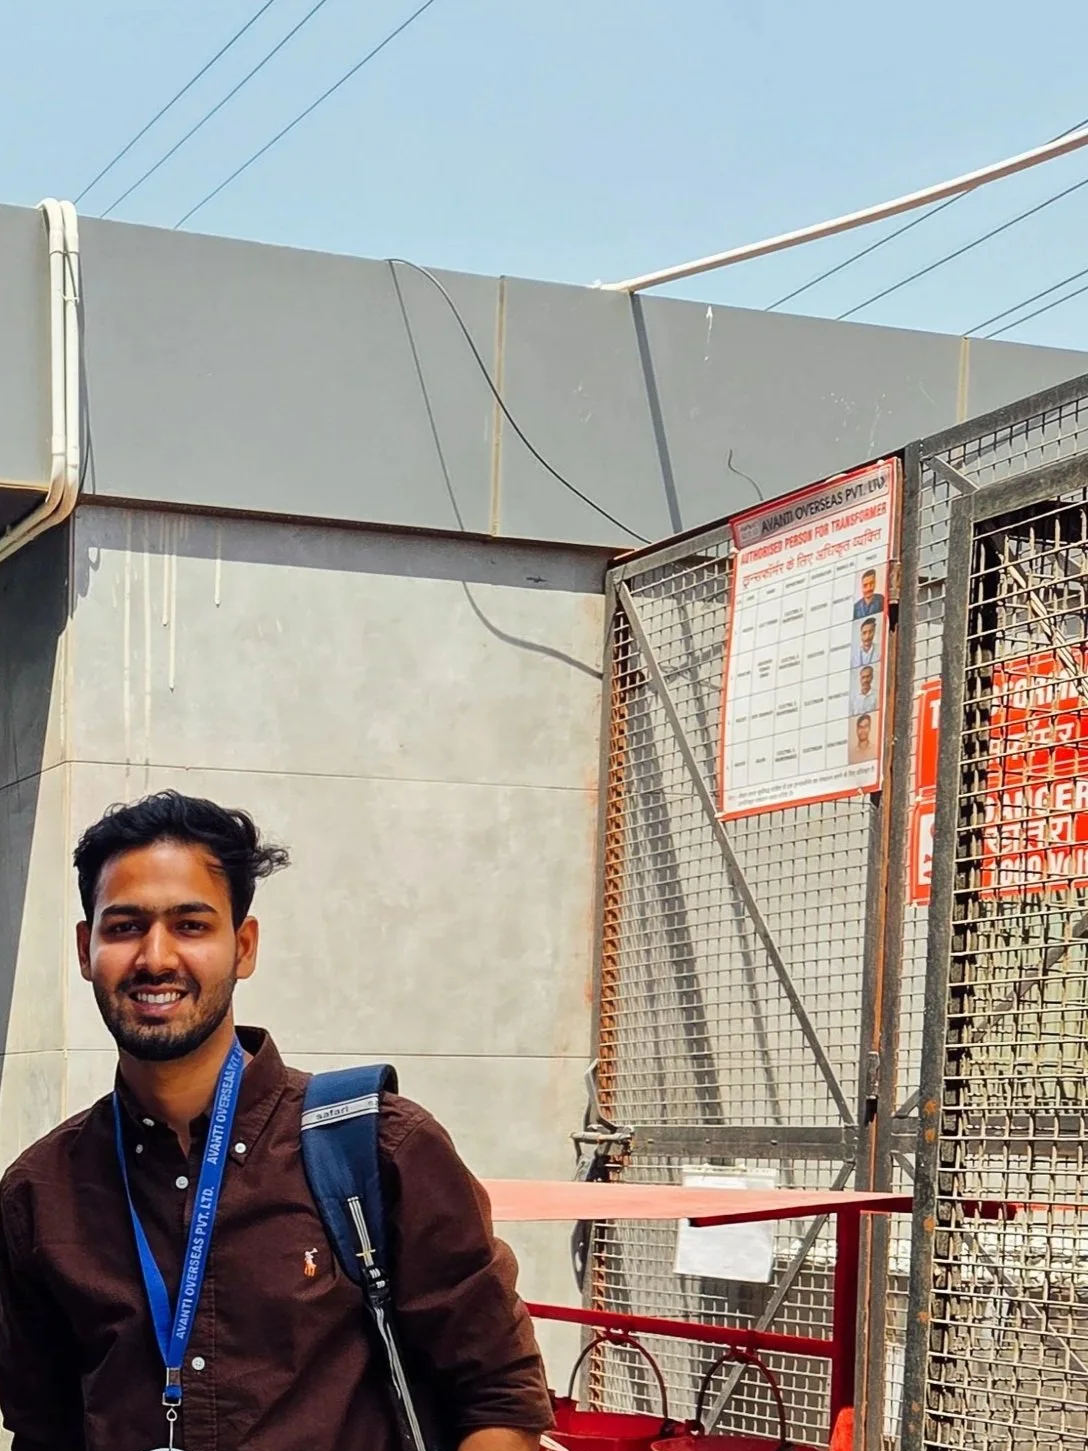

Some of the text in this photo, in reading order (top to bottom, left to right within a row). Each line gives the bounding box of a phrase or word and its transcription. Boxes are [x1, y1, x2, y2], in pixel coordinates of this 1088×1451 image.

[761, 511, 793, 533] AVANTI
[795, 492, 844, 520] OVERSEAS
[846, 484, 866, 501] PVT.
[785, 530, 812, 549] PERSON
[814, 522, 829, 539] FOR
[831, 501, 887, 533] TRANSFORMER
[786, 555, 795, 570] के
[797, 552, 813, 567] लिए
[315, 1106, 349, 1120] safari
[207, 1125, 225, 1165] AVANTI
[176, 1185, 215, 1340] AVANTI OVERSEAS PVT. LTD.
